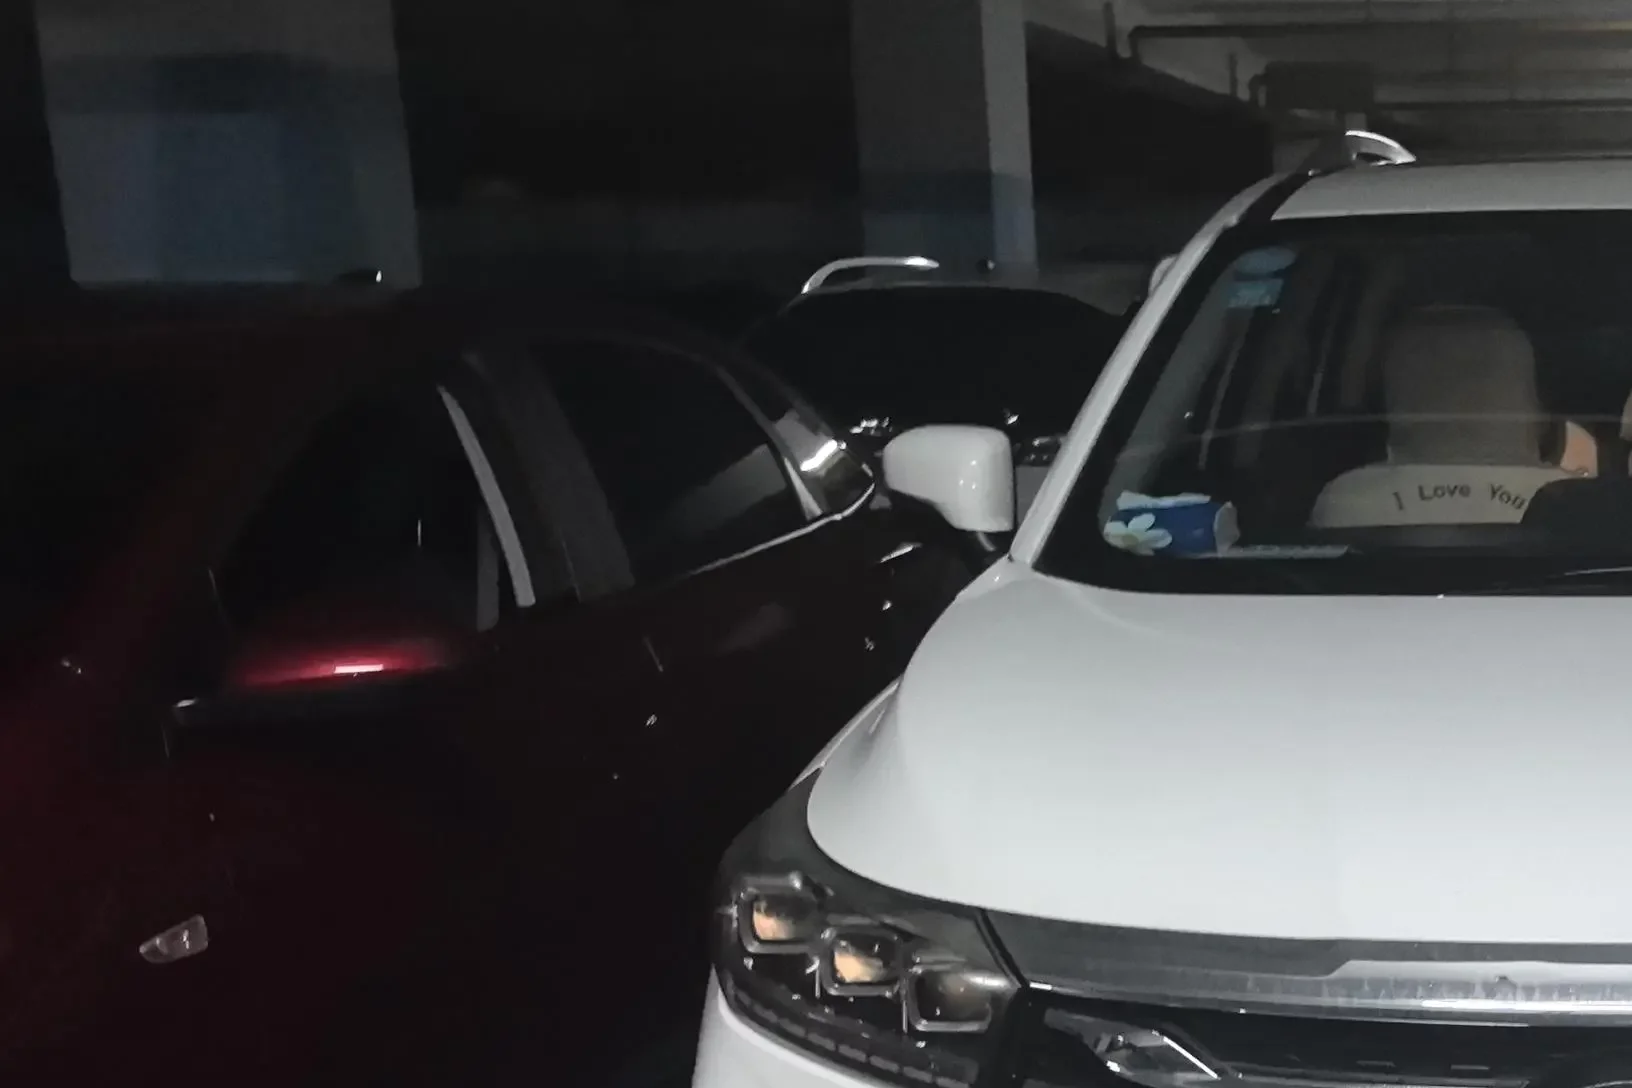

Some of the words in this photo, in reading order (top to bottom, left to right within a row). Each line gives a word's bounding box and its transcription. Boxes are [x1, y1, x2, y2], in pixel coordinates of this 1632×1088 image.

[1392, 491, 1404, 511] I
[1418, 484, 1472, 502] Love
[1489, 483, 1527, 510] You
